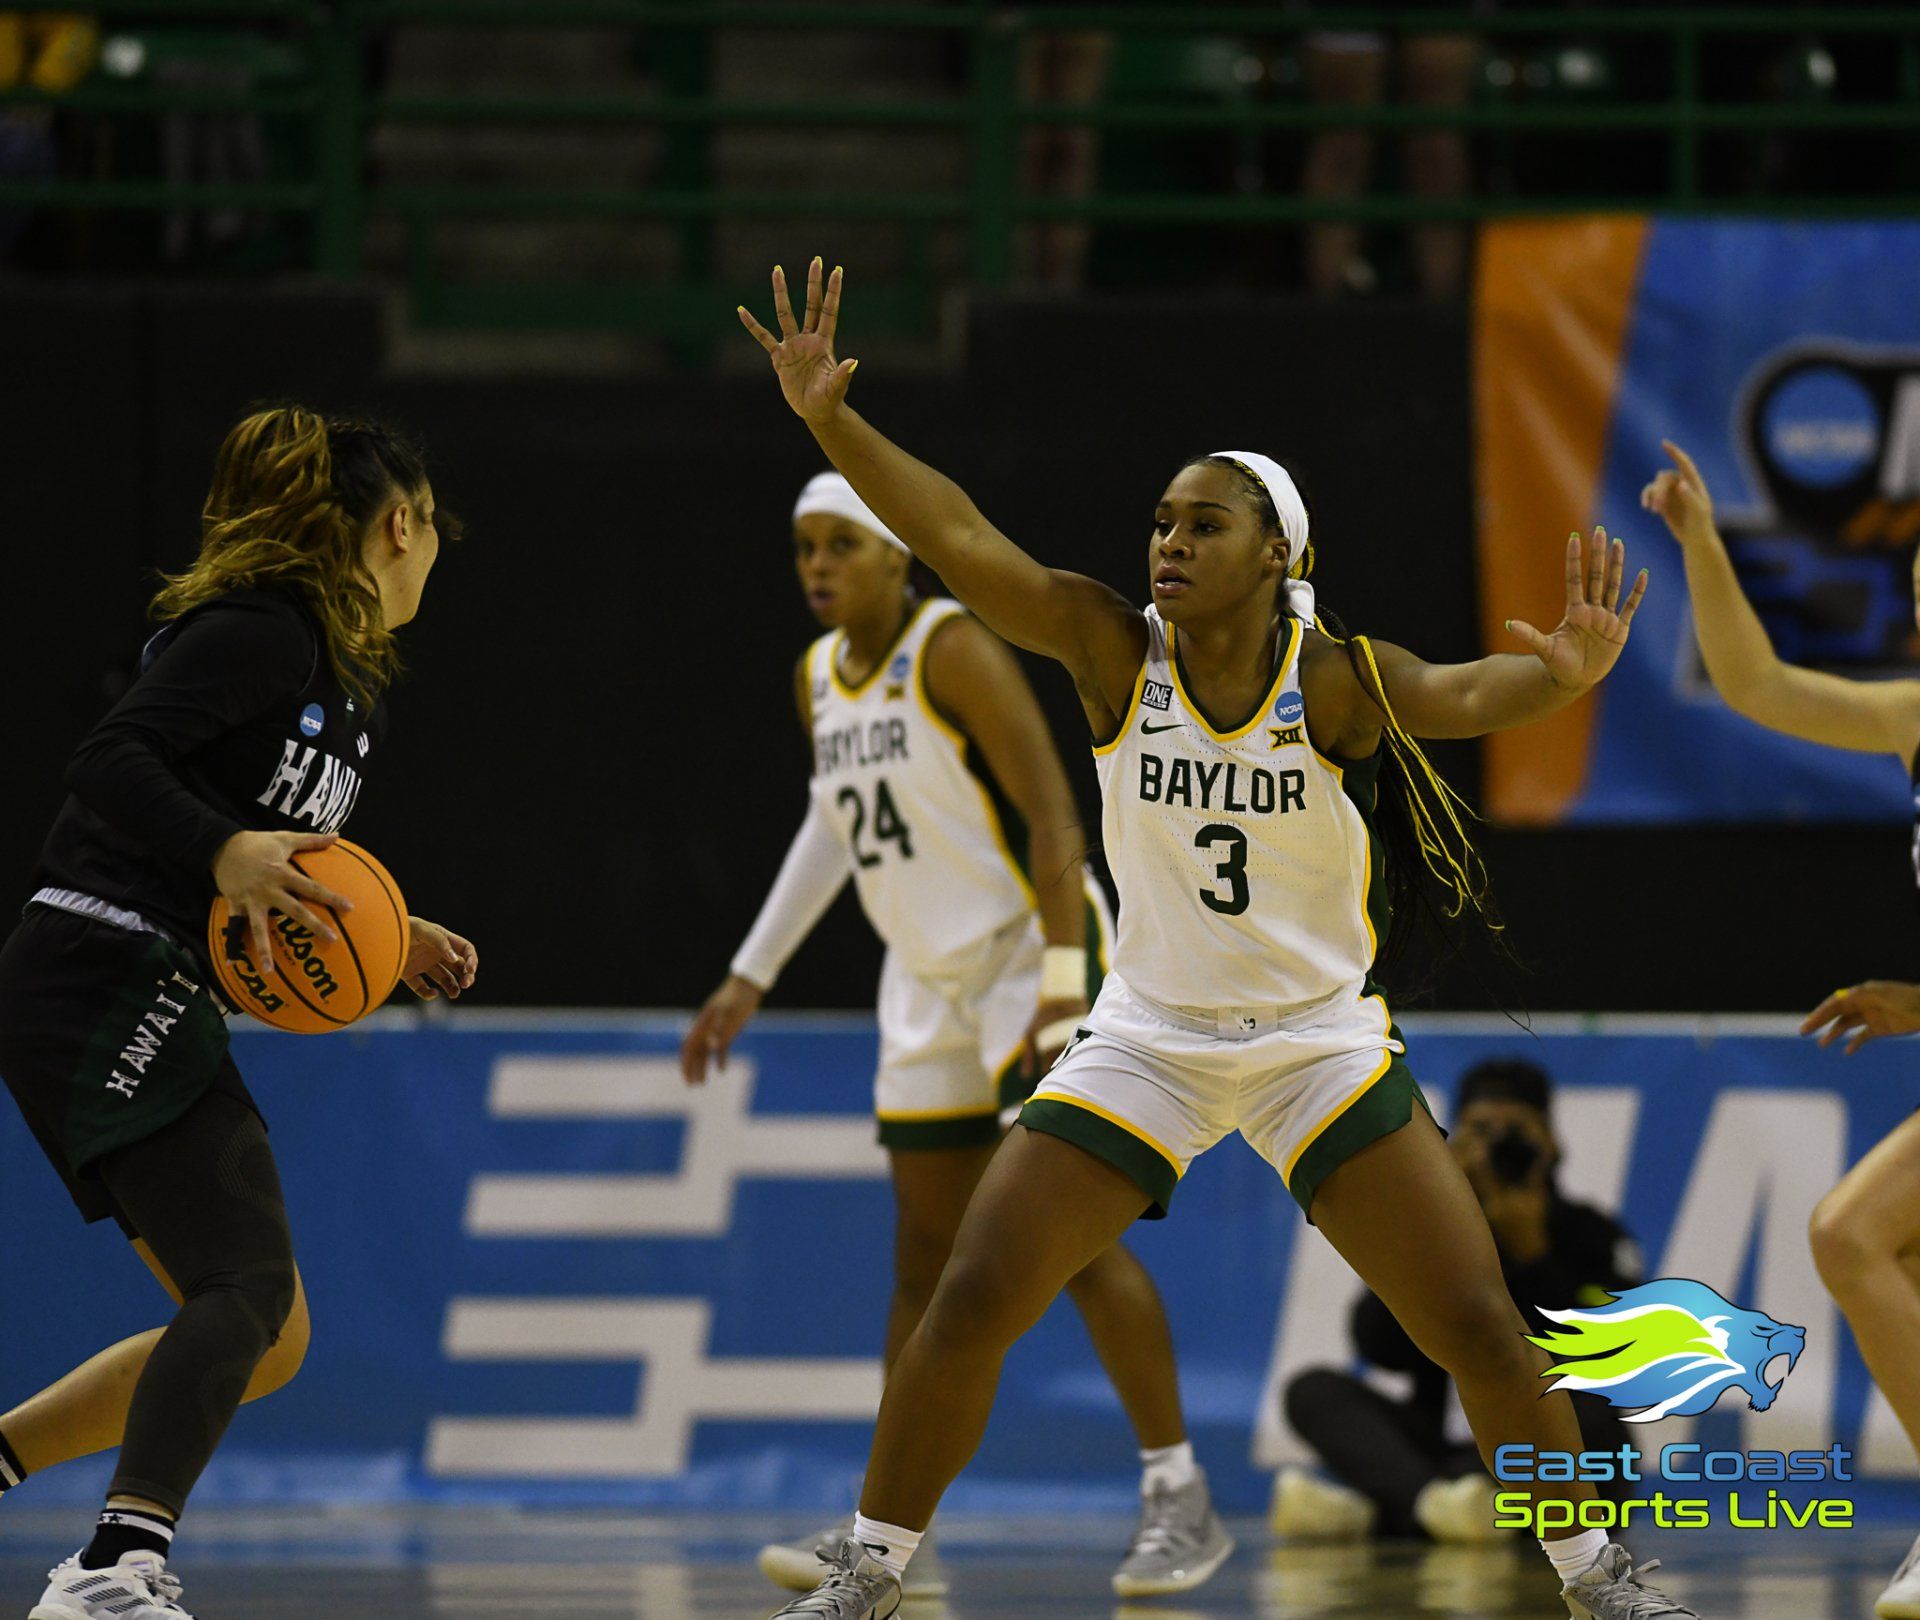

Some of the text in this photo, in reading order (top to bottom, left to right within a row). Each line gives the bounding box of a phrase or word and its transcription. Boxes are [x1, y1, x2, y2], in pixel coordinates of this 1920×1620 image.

[1144, 682, 1171, 704] ONE
[1280, 703, 1302, 715] NCAA
[1269, 725, 1304, 747] XII
[1140, 753, 1306, 813] BAYLOR
[837, 778, 914, 867] 24
[1194, 823, 1250, 916] 3
